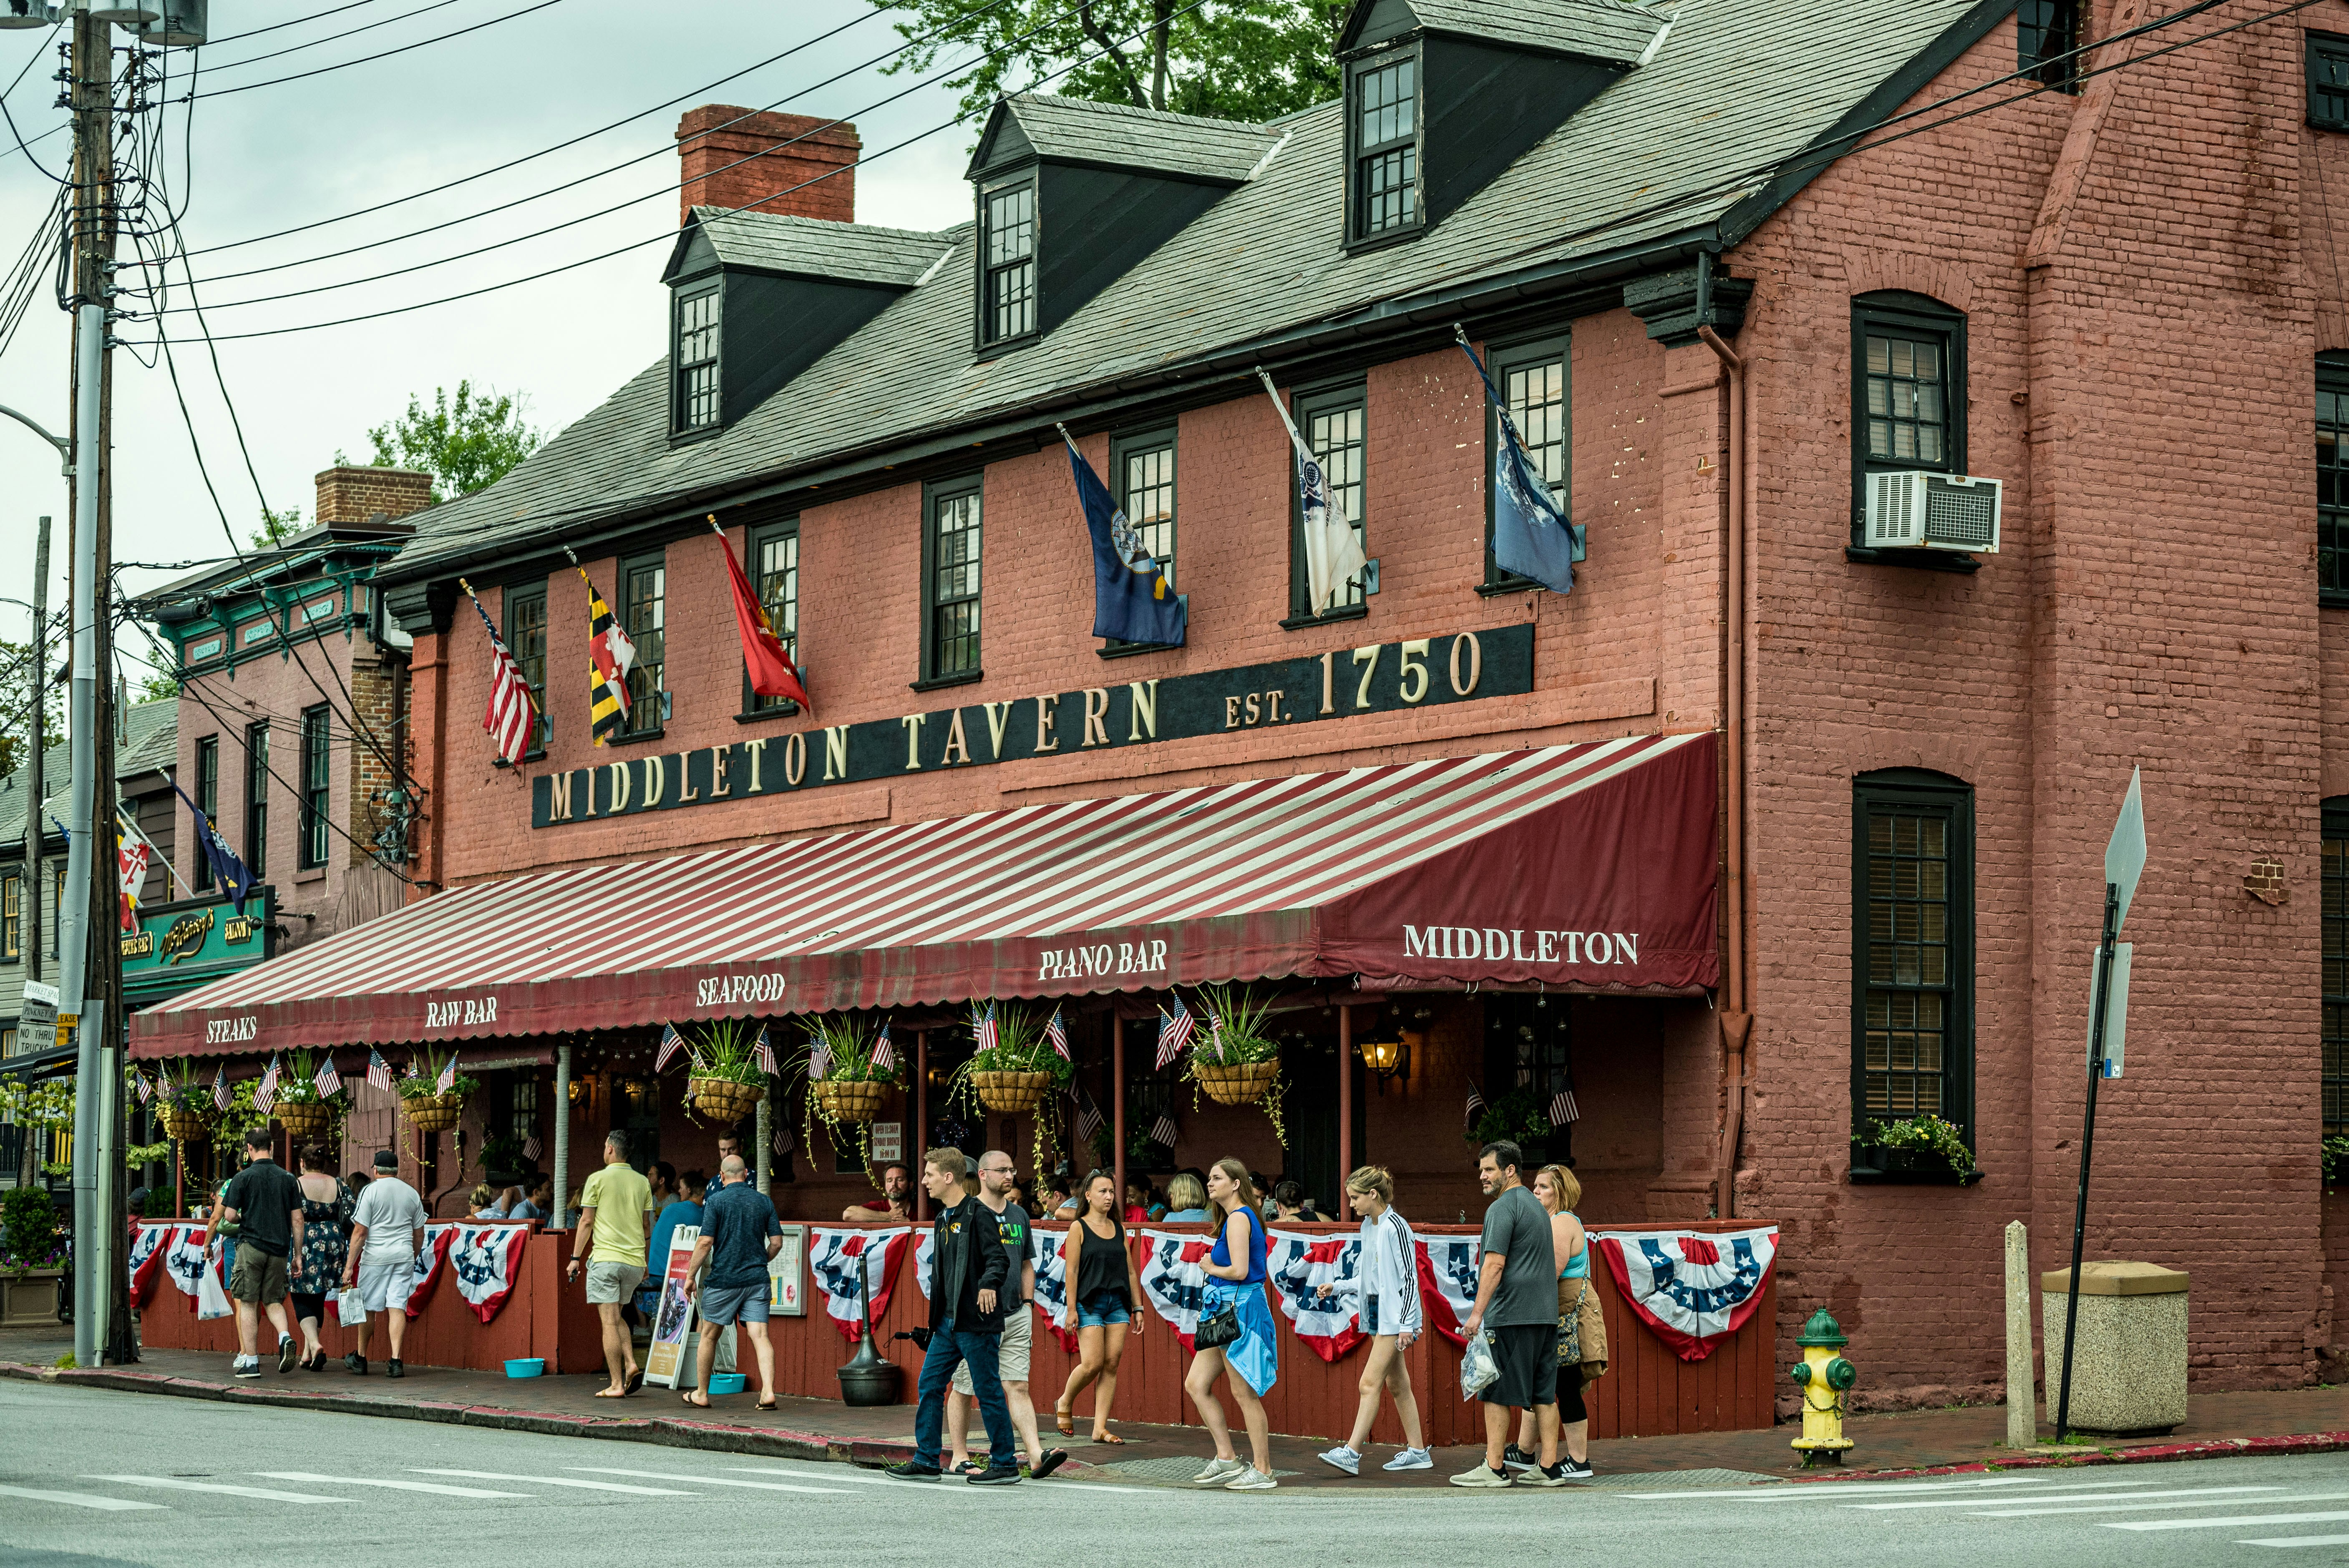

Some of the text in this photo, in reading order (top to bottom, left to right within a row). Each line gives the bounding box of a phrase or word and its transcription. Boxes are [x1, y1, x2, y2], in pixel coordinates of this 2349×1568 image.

[549, 632, 1482, 821] MIDDLETON TAVERN EST. 1750
[1402, 924, 1639, 965] MIDDLETON
[1038, 939, 1167, 981] PIANO BAR
[26, 984, 59, 999] MARKET SPAC
[696, 973, 786, 1007] SEAFOOD
[24, 1007, 48, 1017] PINKNEY
[425, 997, 497, 1028] RAW BAR
[20, 1028, 30, 1038] NO
[35, 1029, 53, 1040] THRU
[206, 1016, 257, 1044] STEAKS
[874, 1137, 900, 1146] SUNDAY BRUNCH
[875, 1125, 884, 1134] OPEN
